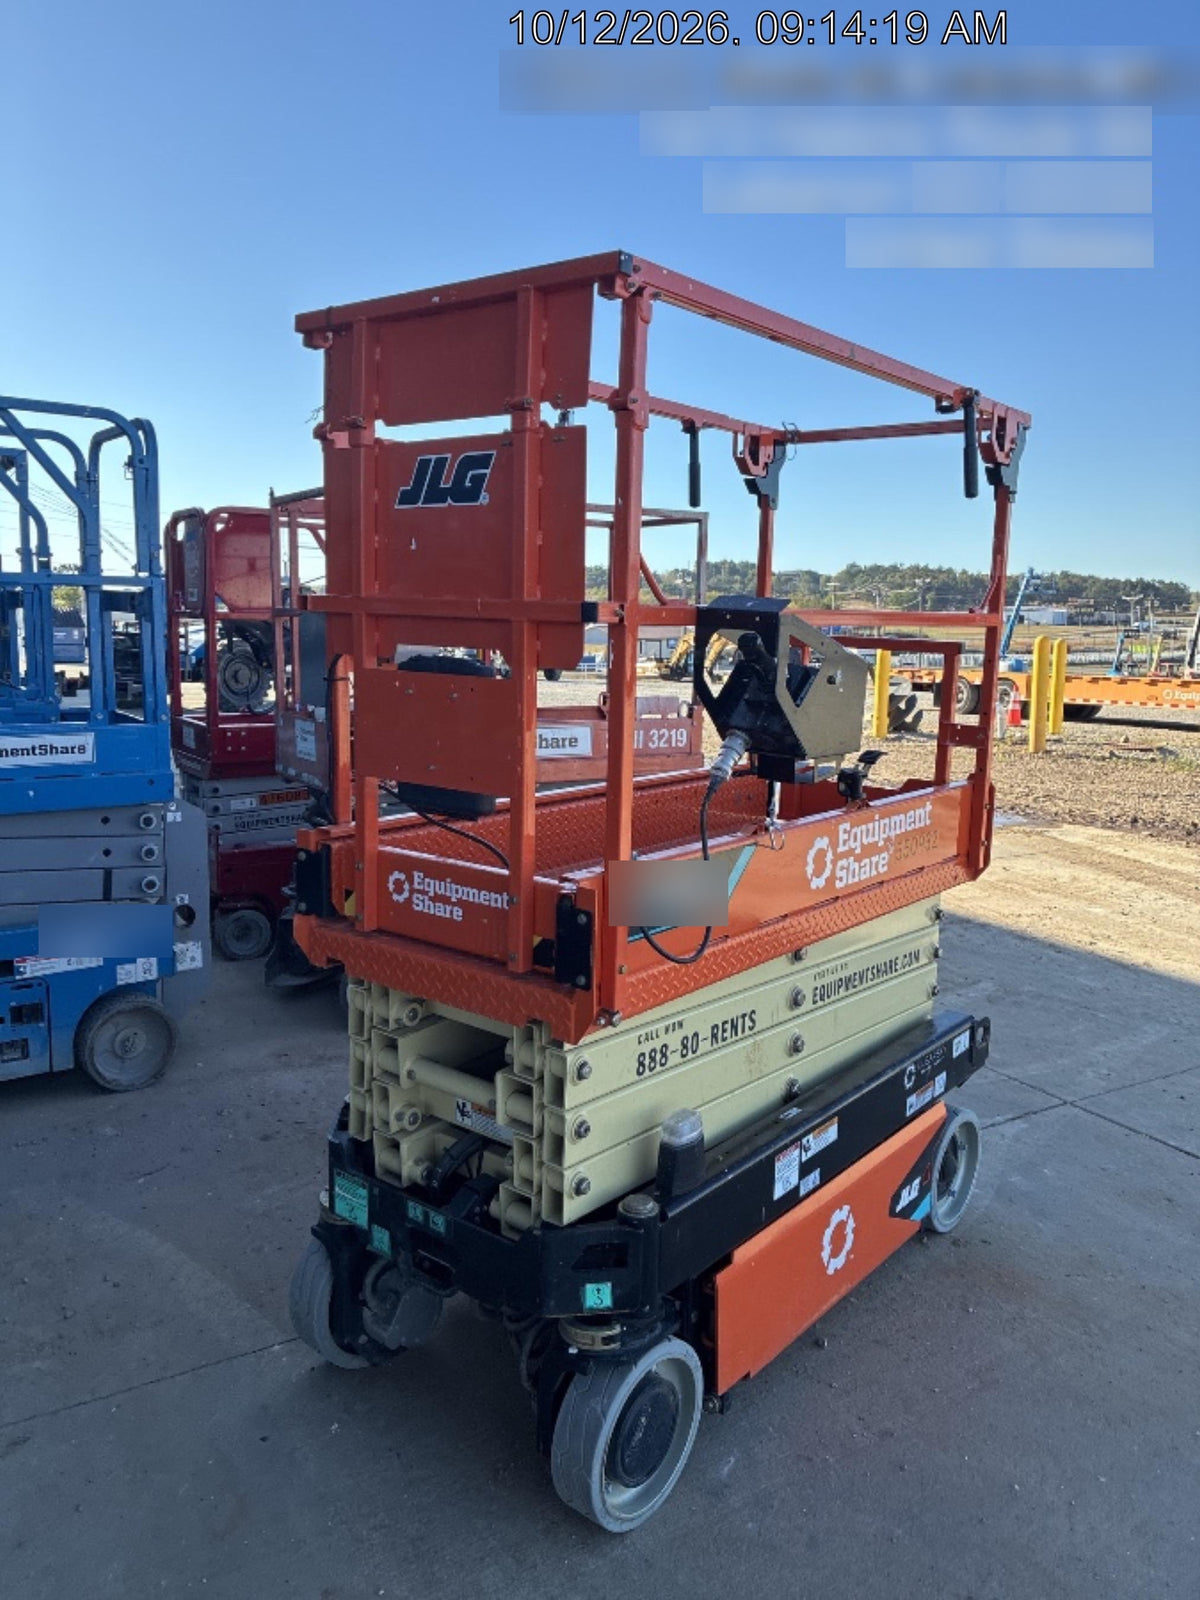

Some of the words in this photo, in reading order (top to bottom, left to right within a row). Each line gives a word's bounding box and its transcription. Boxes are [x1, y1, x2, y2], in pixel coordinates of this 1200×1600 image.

[394, 451, 496, 509] JLG
[537, 733, 579, 749] hare
[648, 728, 688, 750] 3219
[837, 802, 932, 854] Equipment
[835, 850, 890, 889] Share
[412, 870, 510, 910] Equipment
[412, 893, 463, 922] Share
[636, 1009, 757, 1077] 888-80-RENTS
[637, 1028, 660, 1046] CALL
